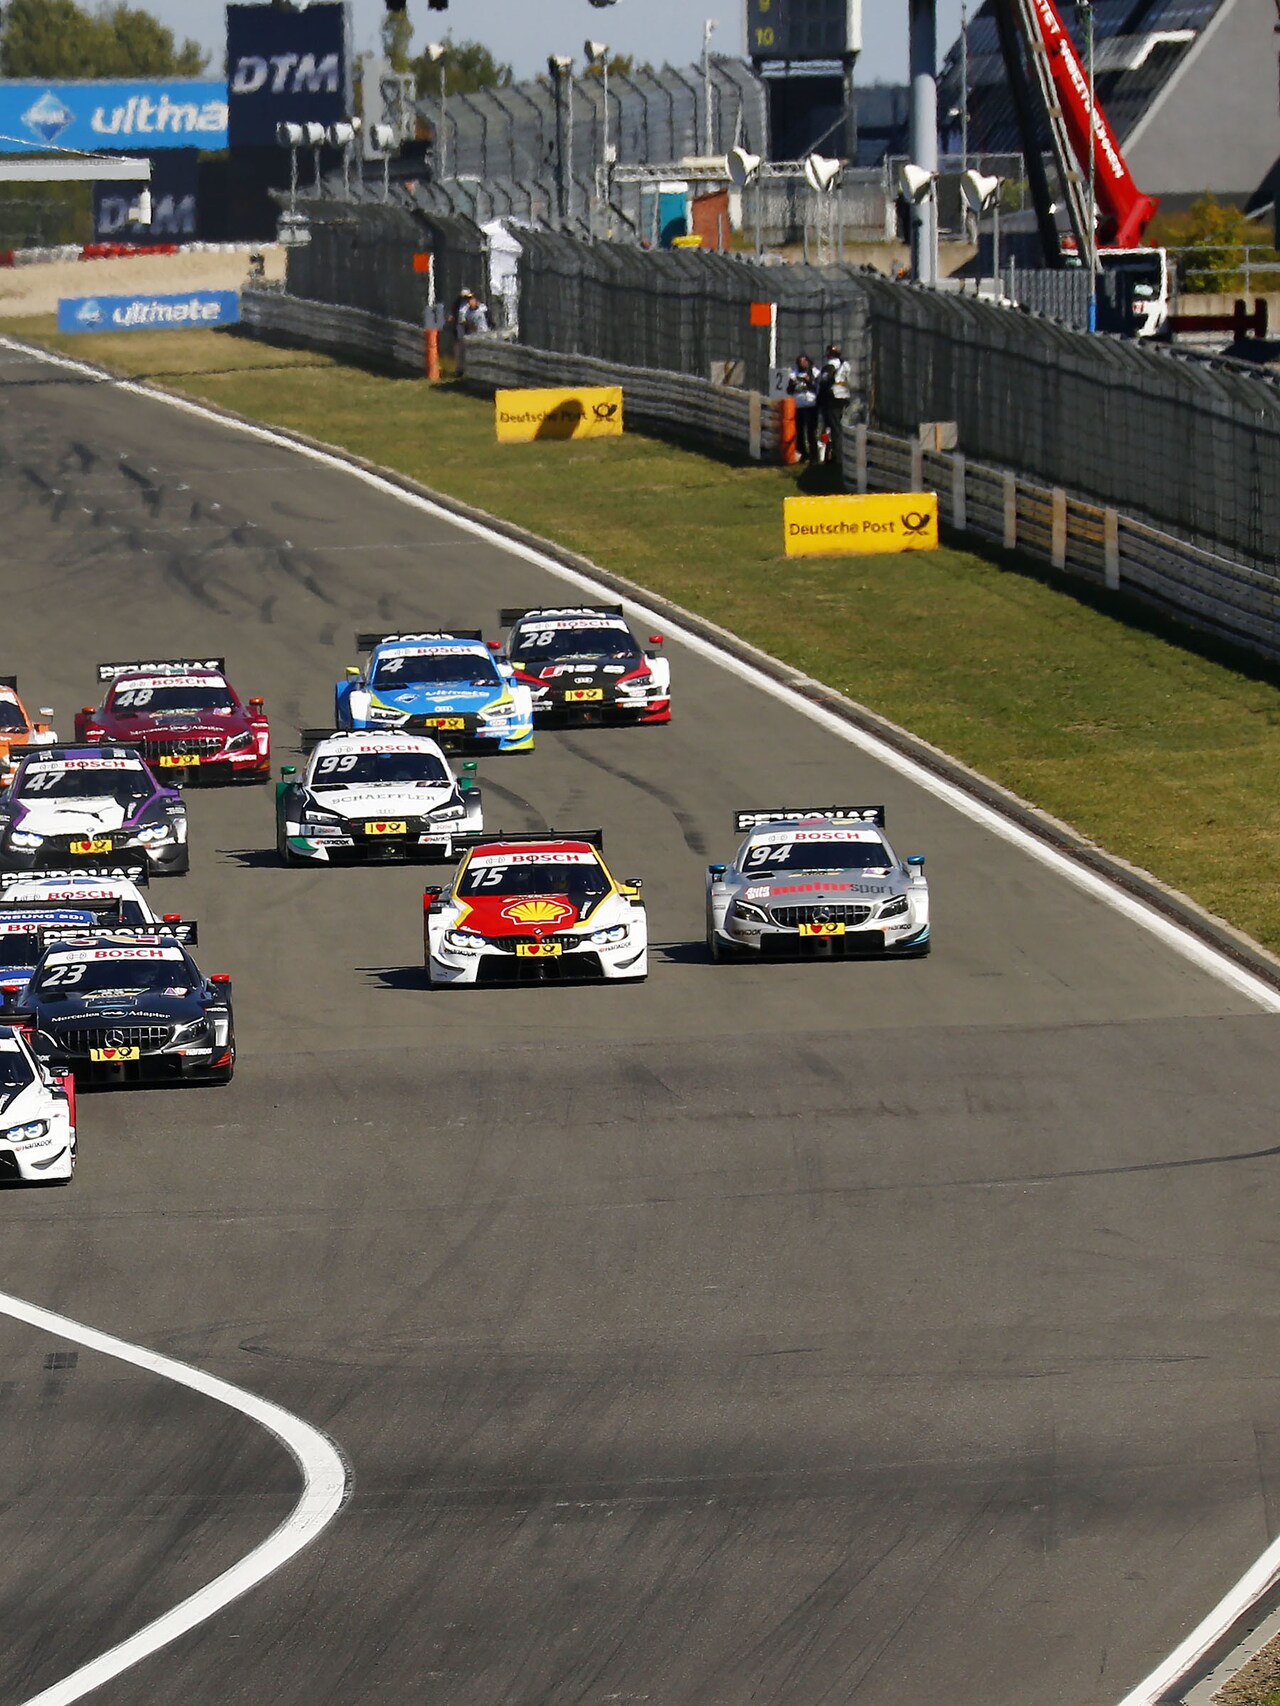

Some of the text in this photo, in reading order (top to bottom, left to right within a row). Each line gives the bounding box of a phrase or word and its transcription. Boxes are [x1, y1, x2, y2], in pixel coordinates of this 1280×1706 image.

[232, 53, 339, 95] DTM
[98, 193, 196, 235] DM
[113, 299, 222, 327] ultimate
[775, 372, 784, 391] 2
[500, 411, 559, 424] Deutsche
[790, 520, 895, 537] Deutsche Post
[520, 631, 556, 649] 28
[381, 658, 405, 673] 4
[151, 678, 207, 686] BOSCH
[115, 689, 154, 707] 48
[64, 761, 126, 769] BOSCH
[319, 755, 358, 774] 99
[24, 772, 66, 791] 47
[332, 793, 436, 805] SCHAEFFLER
[795, 832, 860, 840] BOSCH
[512, 854, 579, 863] BOSCH
[748, 844, 793, 867] 94
[469, 866, 508, 889] 15
[48, 890, 114, 900] BOSCH
[58, 913, 84, 921] SDI
[94, 950, 163, 959] BOSCH
[41, 964, 88, 988] 23
[51, 1011, 100, 1022] Mercedes
[128, 1010, 171, 1020] Adapter
[22, 1139, 53, 1151] Hankook
